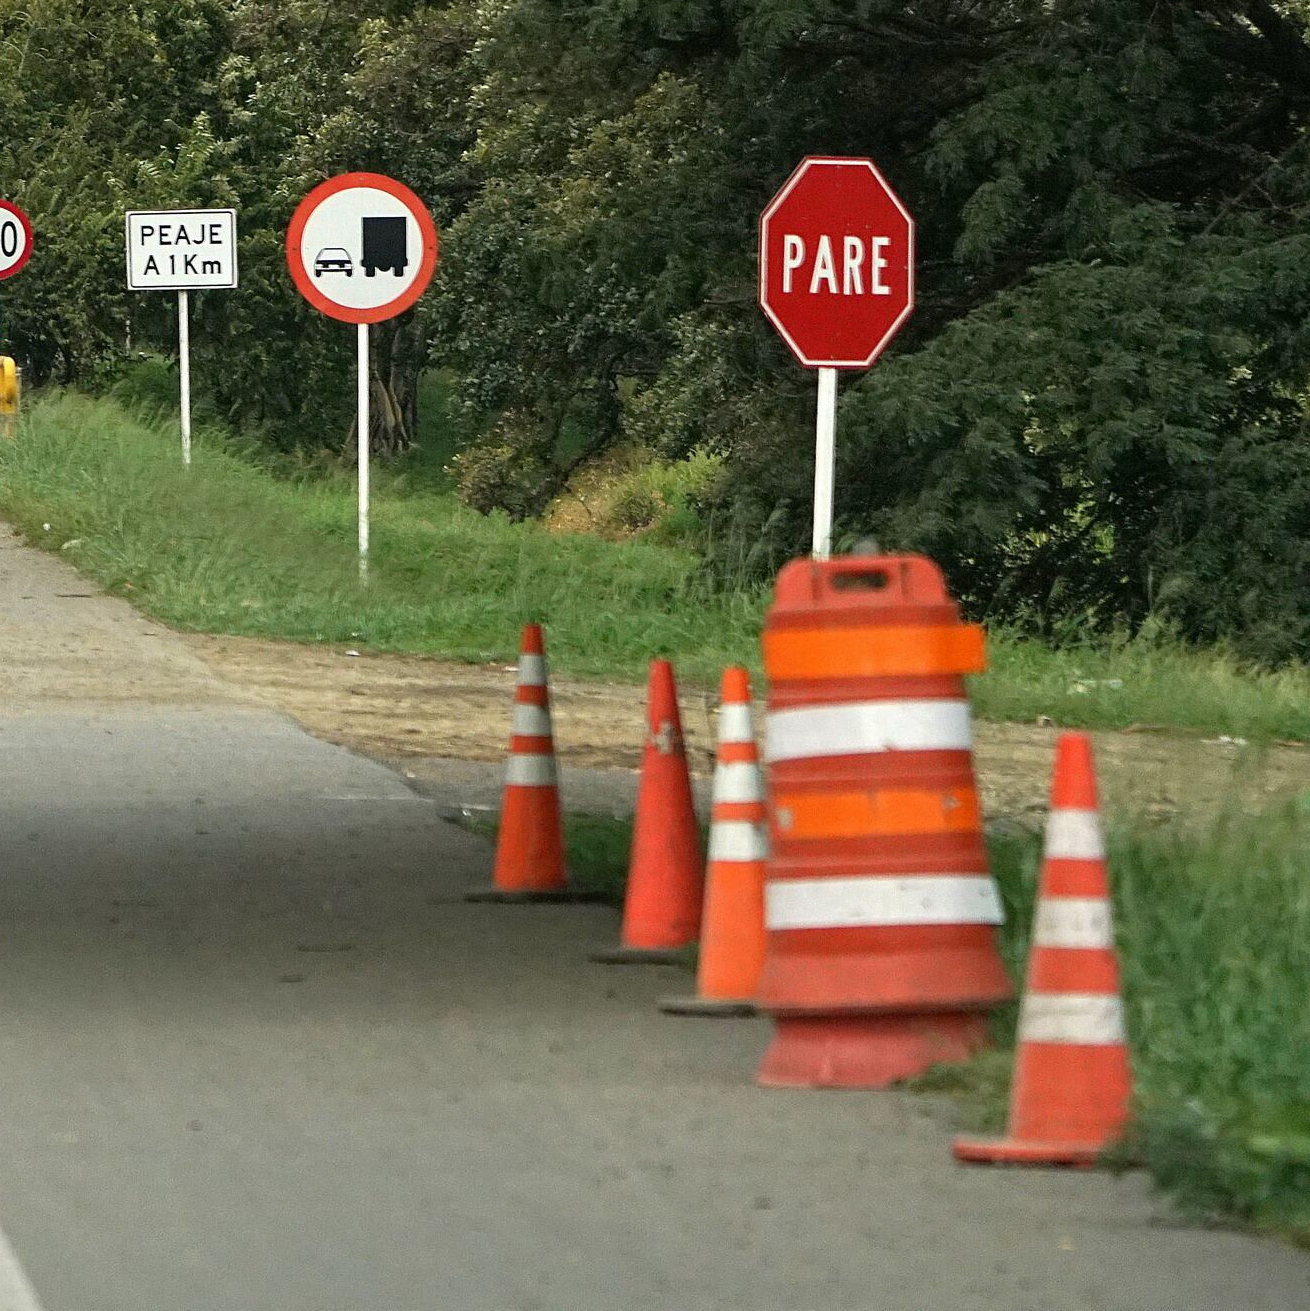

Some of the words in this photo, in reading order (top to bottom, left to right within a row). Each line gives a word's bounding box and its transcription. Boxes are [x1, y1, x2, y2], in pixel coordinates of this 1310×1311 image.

[141, 224, 223, 246] PEAJE
[143, 255, 161, 276] A
[169, 254, 176, 275] 1
[184, 254, 222, 275] Km
[783, 234, 892, 295] PARE
